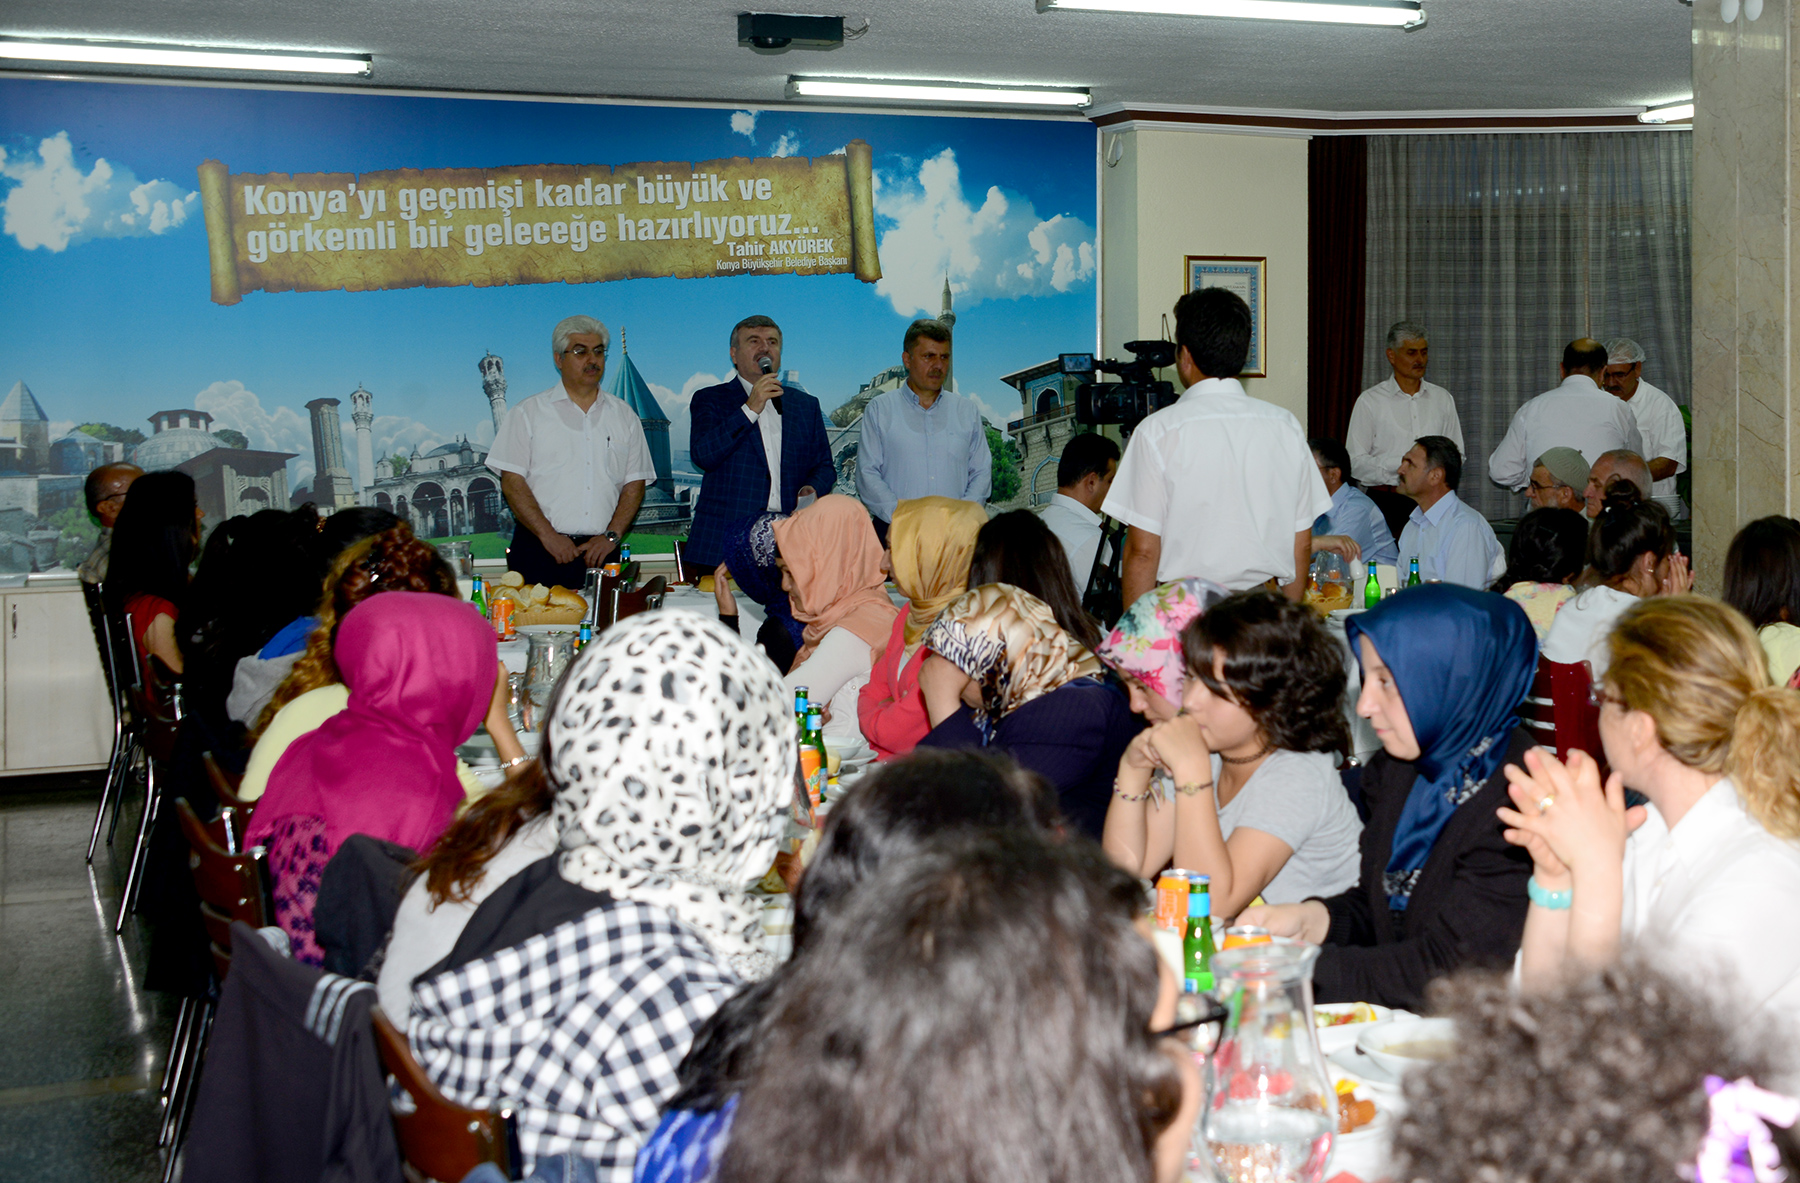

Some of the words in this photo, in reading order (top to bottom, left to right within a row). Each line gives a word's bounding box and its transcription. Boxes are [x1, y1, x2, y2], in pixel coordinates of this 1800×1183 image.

[400, 179, 523, 220] geçmişi
[535, 178, 626, 207] kadar
[637, 174, 729, 210] büyük
[738, 177, 772, 200] ve
[248, 220, 396, 263] görkemli
[409, 219, 453, 249] bir
[465, 213, 606, 256] geleceğe
[618, 211, 819, 244] hazırlıyoruz...
[727, 241, 765, 257] Tahir
[769, 236, 834, 255] AKYÜREK
[716, 259, 740, 271] Konya
[742, 257, 784, 271] Büyükşehir
[785, 256, 817, 268] Belediye
[819, 255, 848, 268] Başkanı
